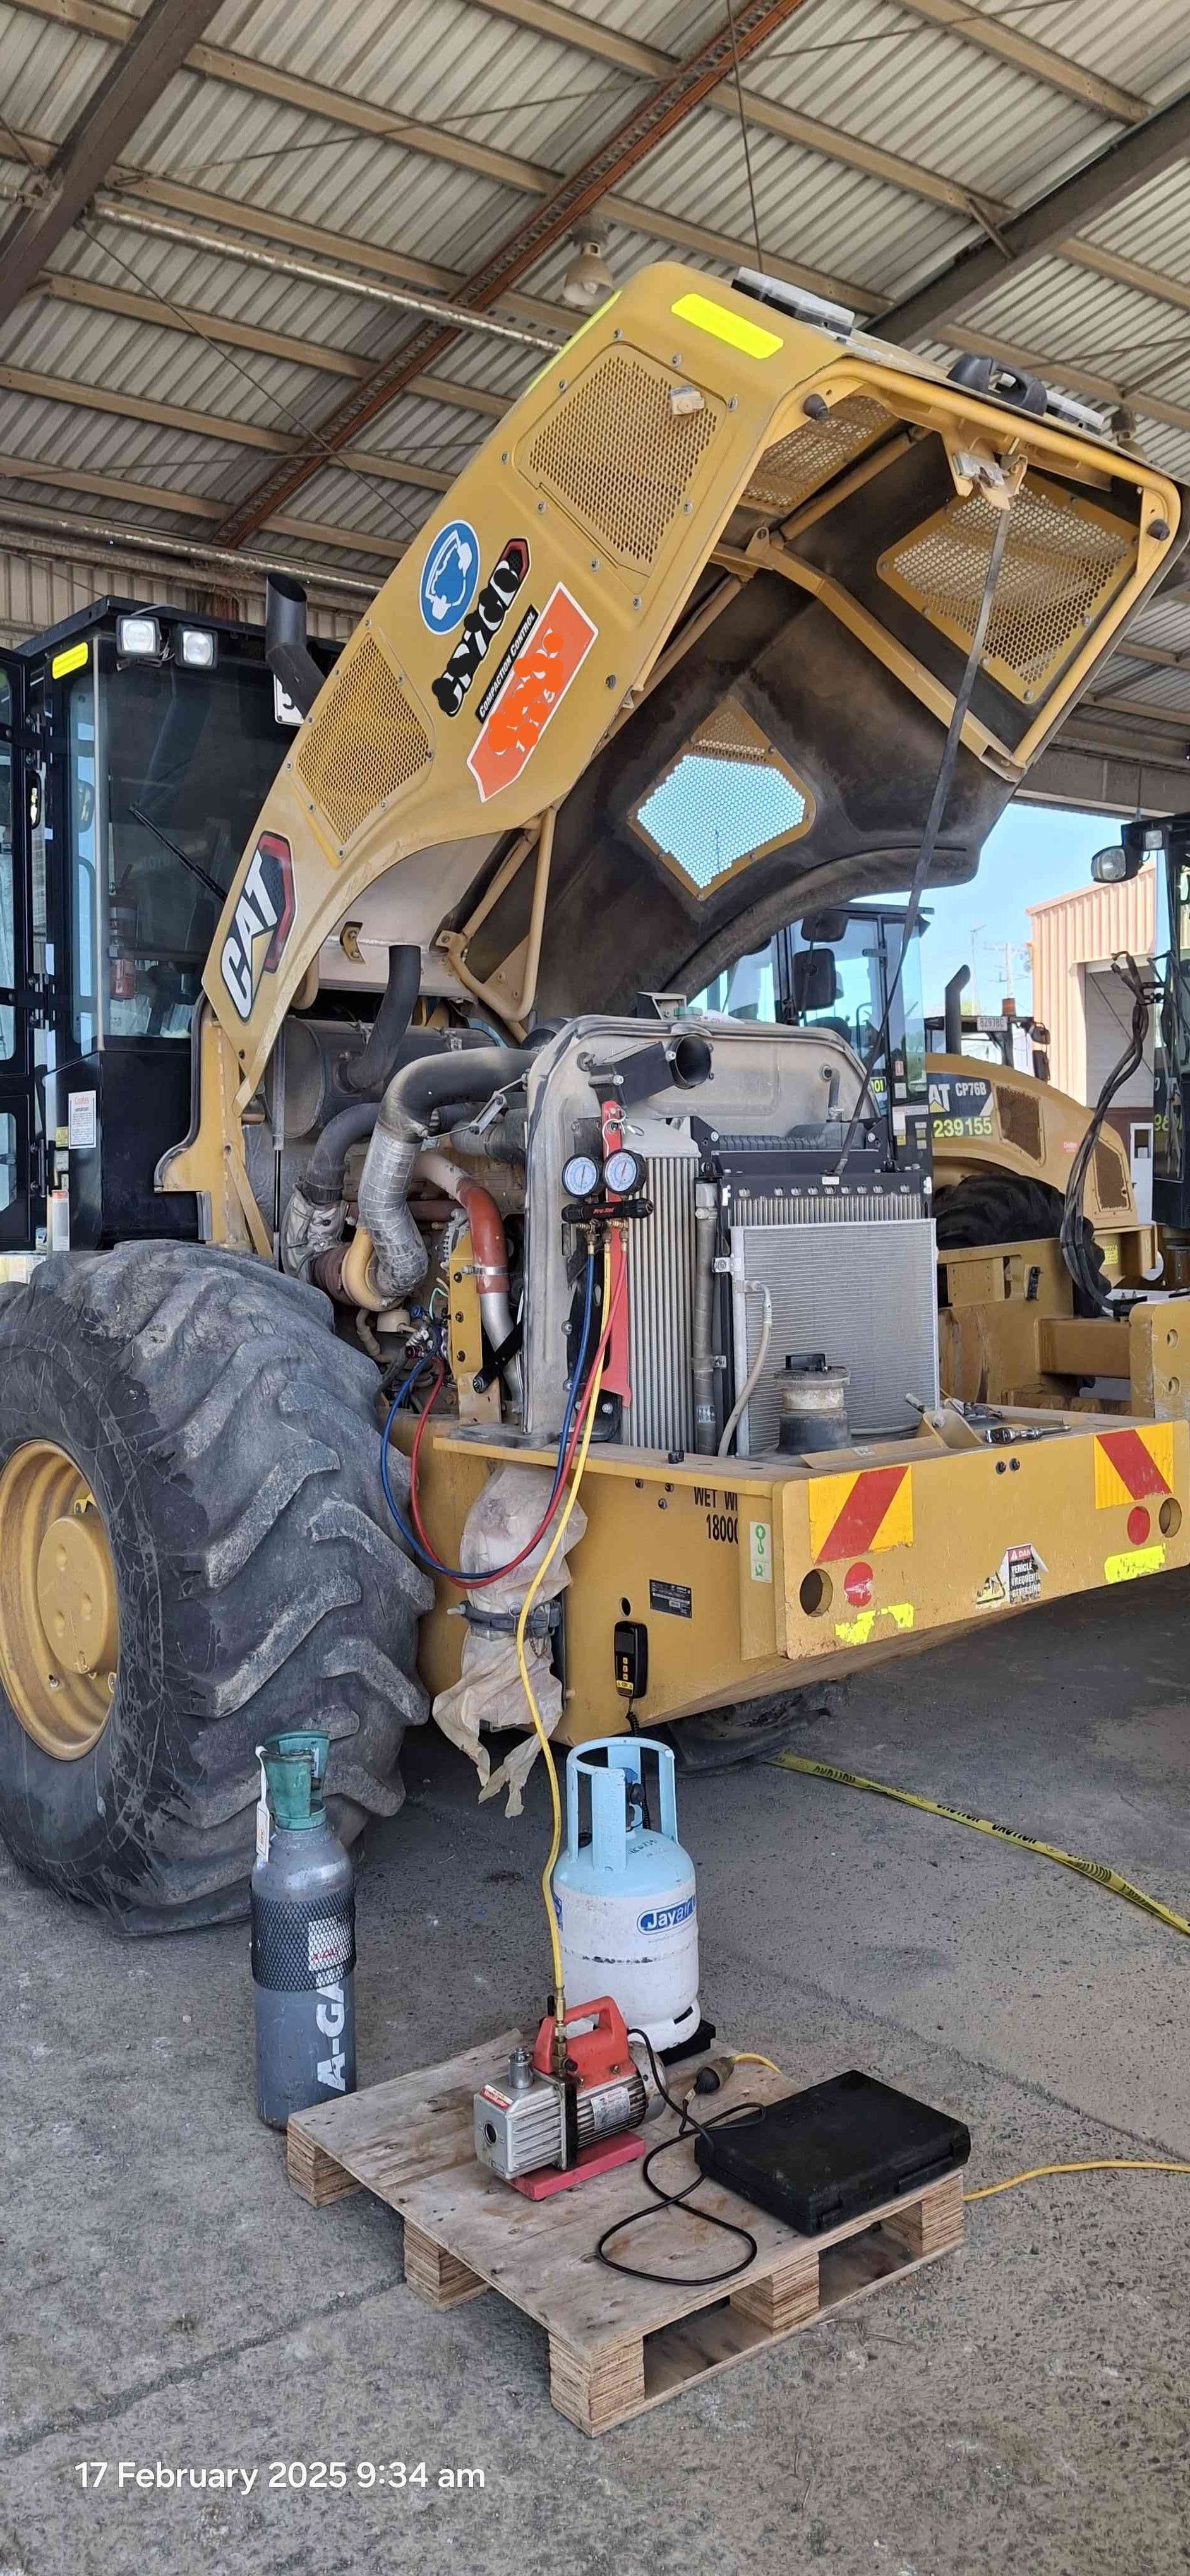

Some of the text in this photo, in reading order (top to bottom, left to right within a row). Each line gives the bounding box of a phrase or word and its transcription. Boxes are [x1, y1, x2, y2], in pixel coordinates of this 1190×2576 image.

[479, 611, 536, 719] COMPACTION CONTROL
[222, 849, 278, 1018] CAT
[955, 1082, 987, 1096] CP76B
[933, 1117, 992, 1138] 239155
[694, 1487, 718, 1508] WET
